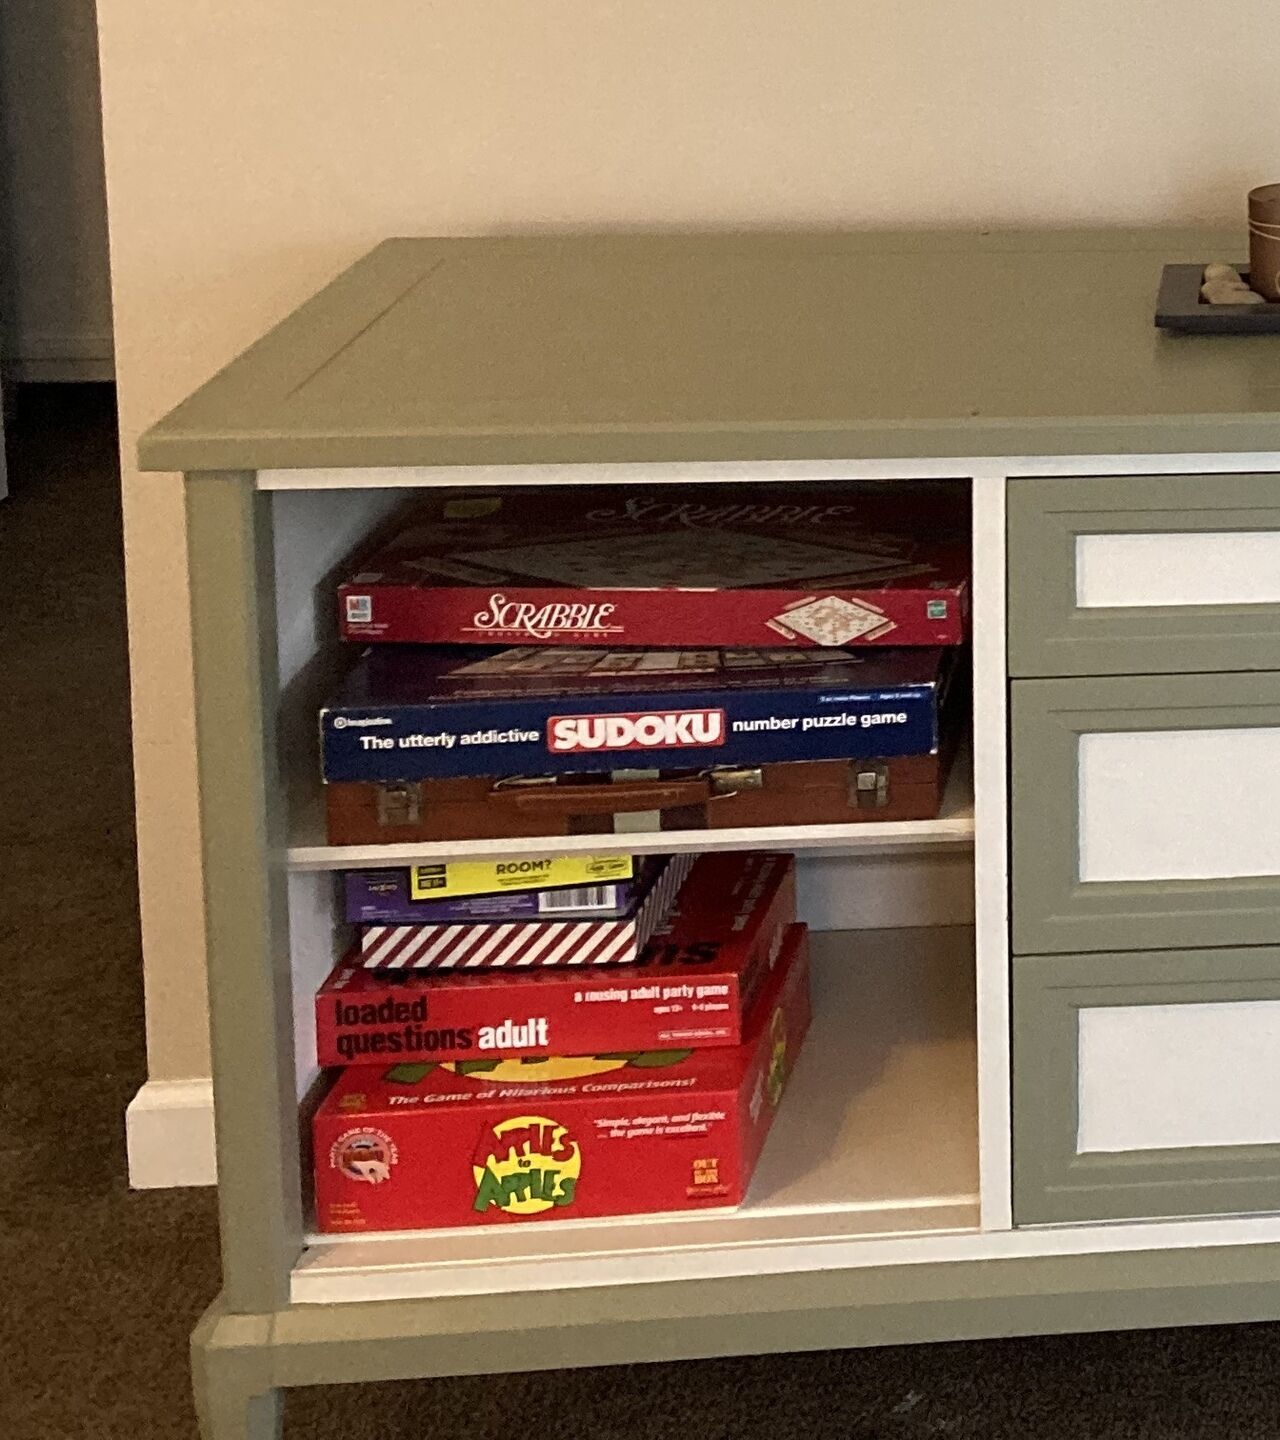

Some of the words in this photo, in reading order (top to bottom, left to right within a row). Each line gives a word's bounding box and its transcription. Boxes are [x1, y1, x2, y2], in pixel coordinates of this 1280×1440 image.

[473, 593, 617, 639] SCRABBLE
[360, 735, 394, 750] The
[398, 732, 456, 749] utterly
[460, 728, 540, 747] addictive
[553, 712, 721, 750] SUDOKU
[732, 716, 799, 732] number
[802, 712, 856, 731] puzzle
[860, 711, 908, 728] game
[496, 859, 552, 875] ROOM?
[630, 985, 660, 1000] adult
[662, 984, 694, 1000] party
[696, 985, 729, 999] game
[335, 995, 428, 1027] loaded
[336, 1023, 474, 1059] questions
[478, 1017, 549, 1051] adult
[388, 1095, 419, 1105] The
[423, 1092, 473, 1103] Game
[476, 1089, 496, 1100] of
[499, 1083, 577, 1098] Hilarious
[581, 1077, 697, 1094] Comparisons!
[473, 1119, 578, 1168] APPLES
[518, 1158, 532, 1169] to
[473, 1166, 577, 1213] APPLES
